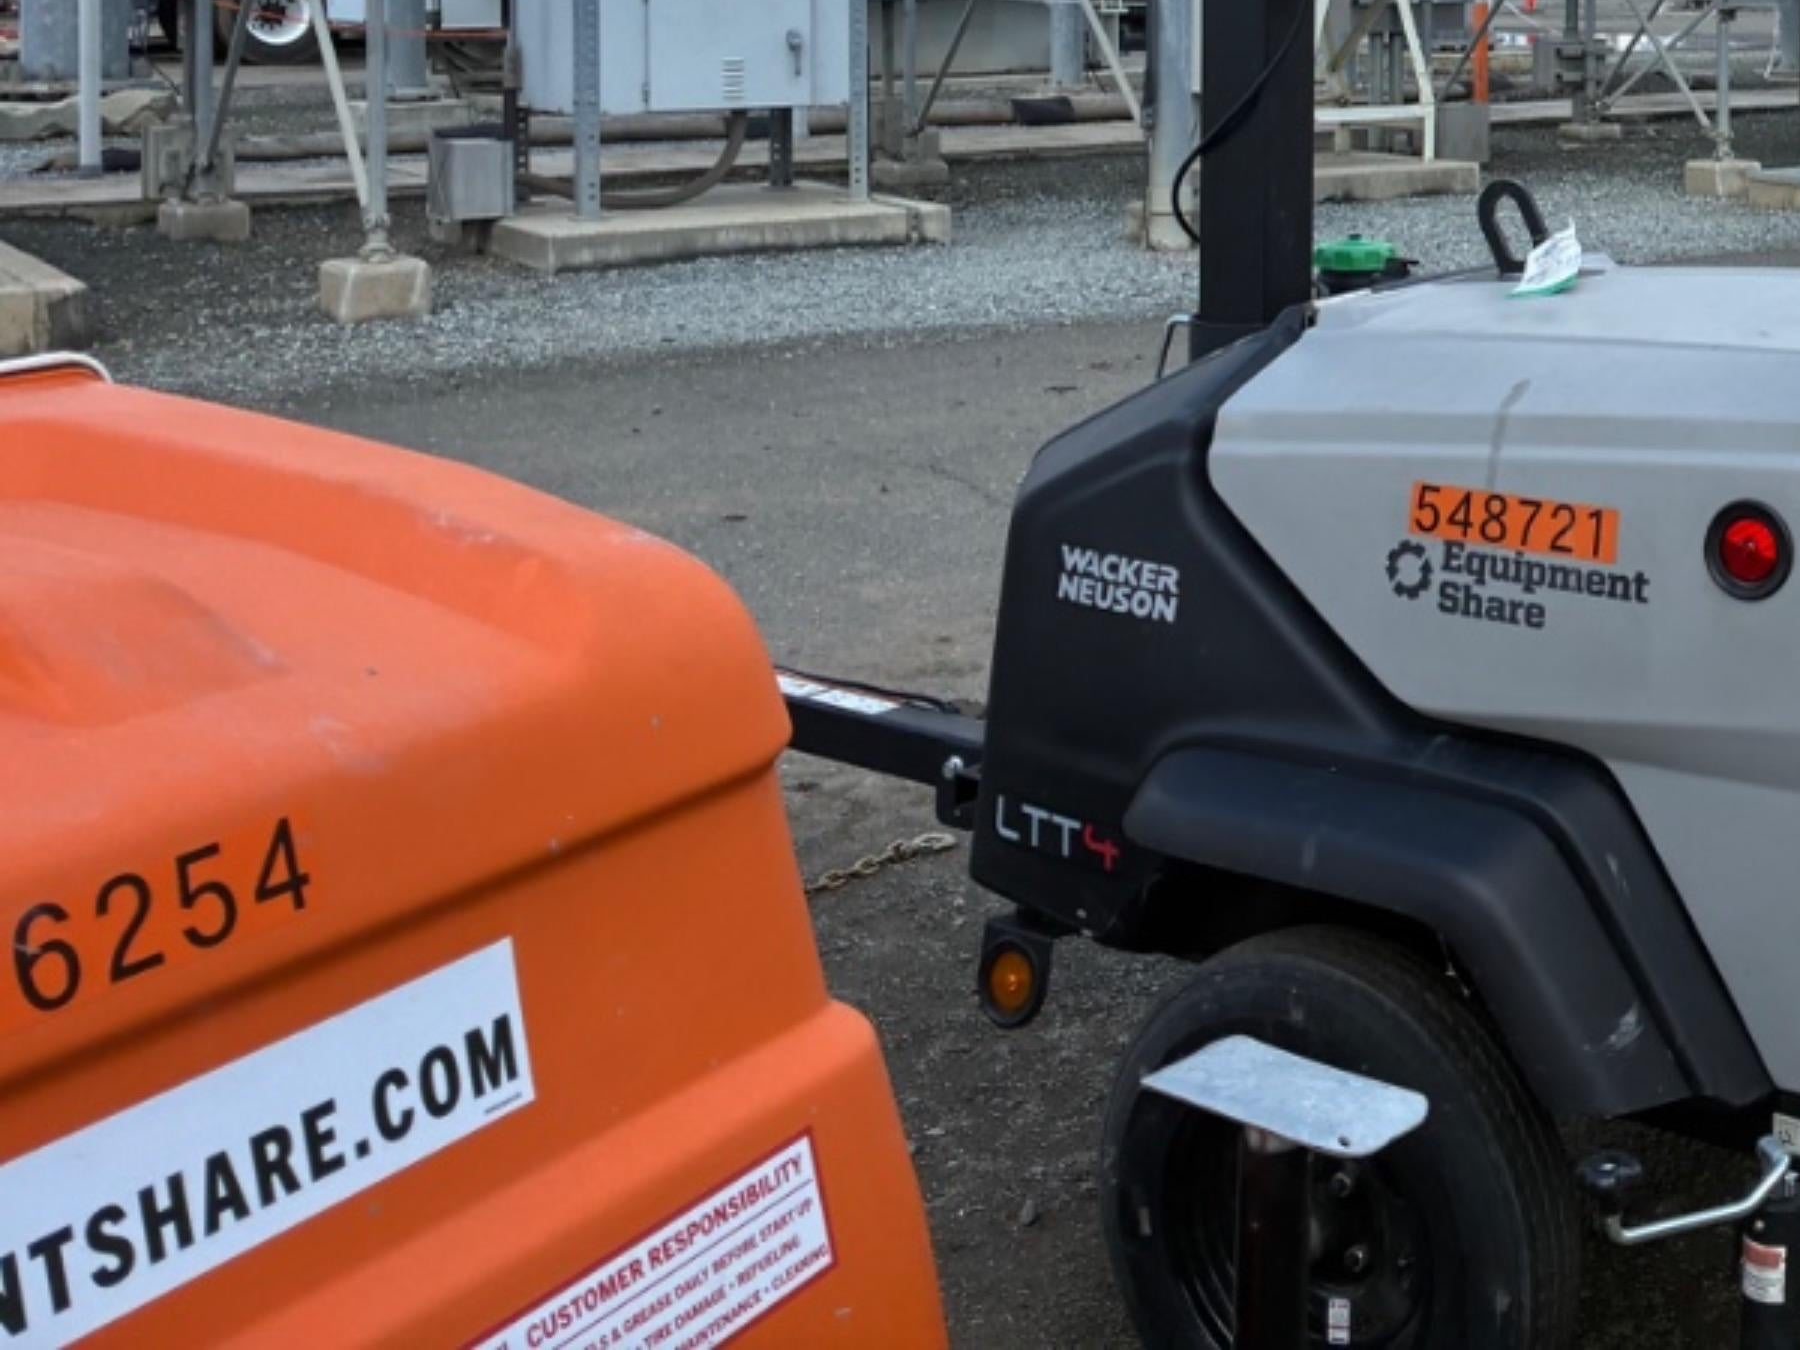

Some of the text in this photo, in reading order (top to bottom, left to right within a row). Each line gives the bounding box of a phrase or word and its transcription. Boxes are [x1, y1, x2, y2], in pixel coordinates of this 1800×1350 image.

[1415, 485, 1605, 558] 548721
[1058, 573, 1178, 623] NEUSON
[1061, 544, 1179, 594] WACKER
[1437, 581, 1546, 629] Share
[1440, 539, 1650, 603] Equipment
[996, 794, 1119, 872] LTT4
[12, 816, 310, 1012] 6254
[526, 1152, 802, 1348] CUSTOMER RESPONSIBILITY
[622, 1293, 673, 1333] GREASE
[674, 1266, 709, 1300] DAILY
[711, 1236, 760, 1275] BEFORE
[771, 1242, 830, 1291] CLEANING
[642, 1233, 800, 1349] TIRE DAMAGE REFUELING
